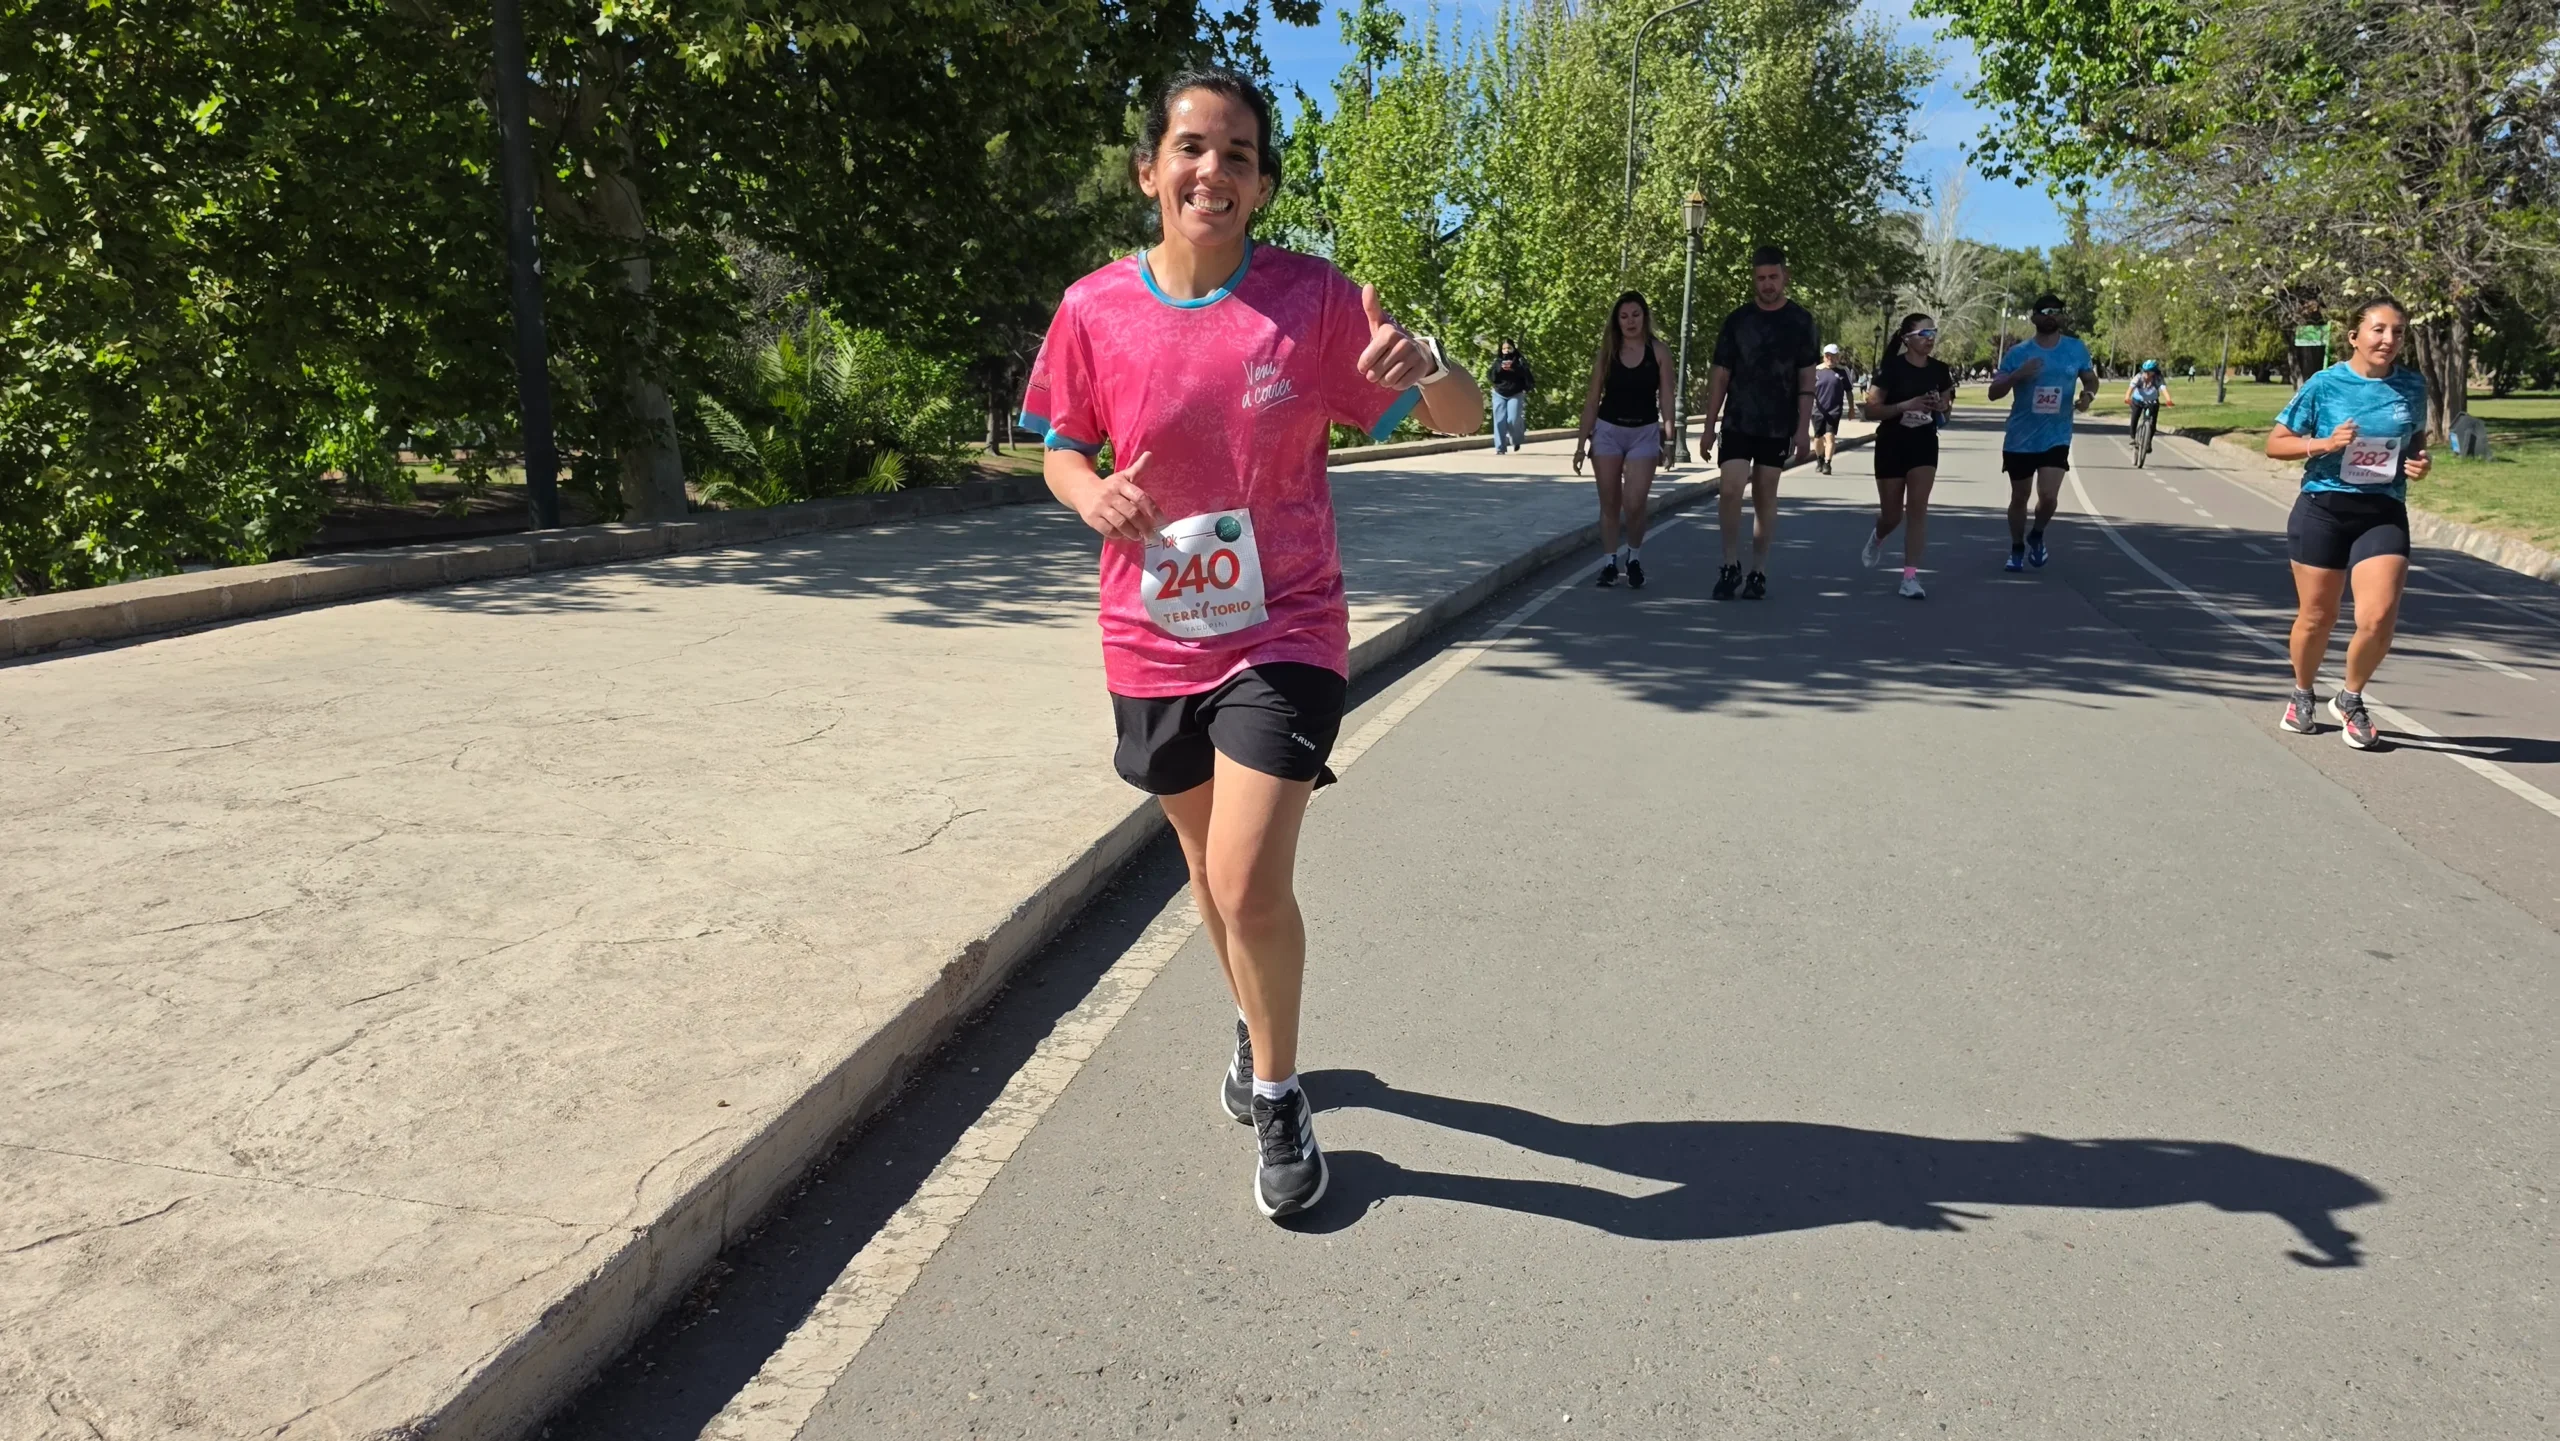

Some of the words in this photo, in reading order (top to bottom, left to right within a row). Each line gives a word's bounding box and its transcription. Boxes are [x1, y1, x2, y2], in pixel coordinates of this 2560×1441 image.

[2036, 393, 2058, 404] 242
[2348, 451, 2391, 467] 282
[1155, 548, 1241, 600] 240
